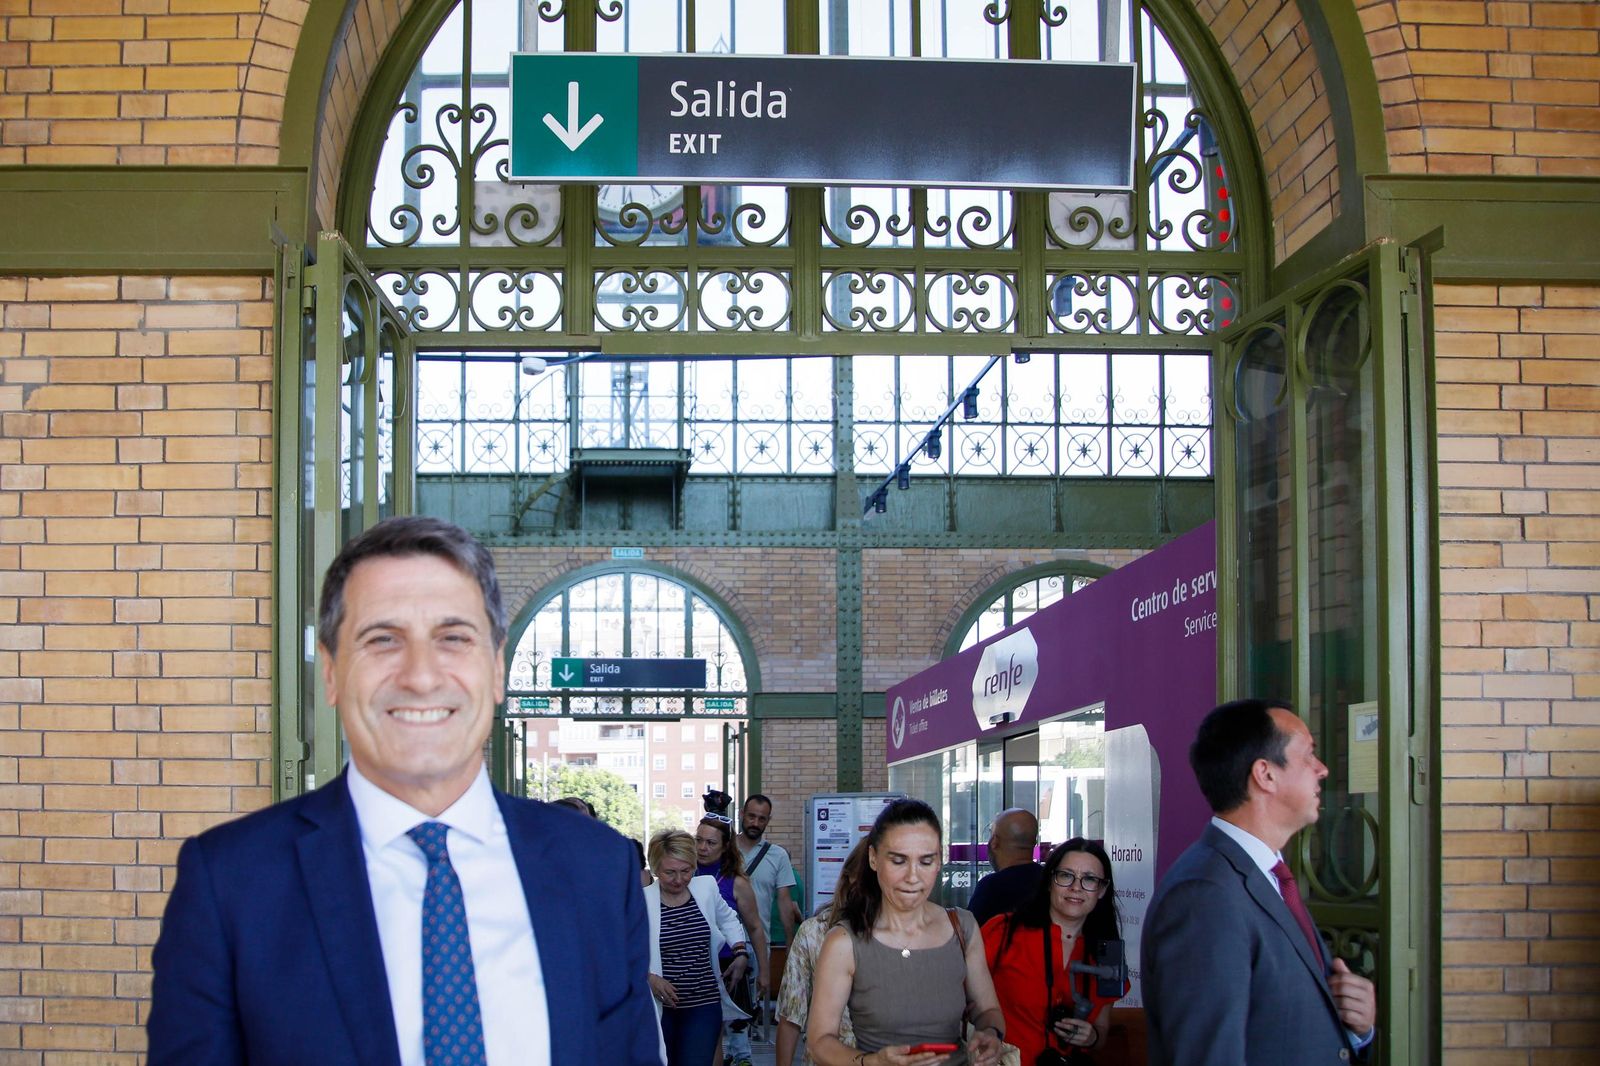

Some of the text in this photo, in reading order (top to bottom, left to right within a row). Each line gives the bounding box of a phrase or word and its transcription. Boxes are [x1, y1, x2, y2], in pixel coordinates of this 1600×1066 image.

[670, 80, 787, 119] Salida
[669, 133, 722, 154] EXIT
[1131, 591, 1168, 622] Centro
[1172, 577, 1187, 605] de
[590, 663, 621, 674] Salida
[984, 652, 1023, 702] renfe
[520, 700, 549, 708] SALIDA
[705, 701, 734, 709] SALIDA
[910, 689, 948, 714] Venta de billetes
[1111, 843, 1143, 862] Horario
